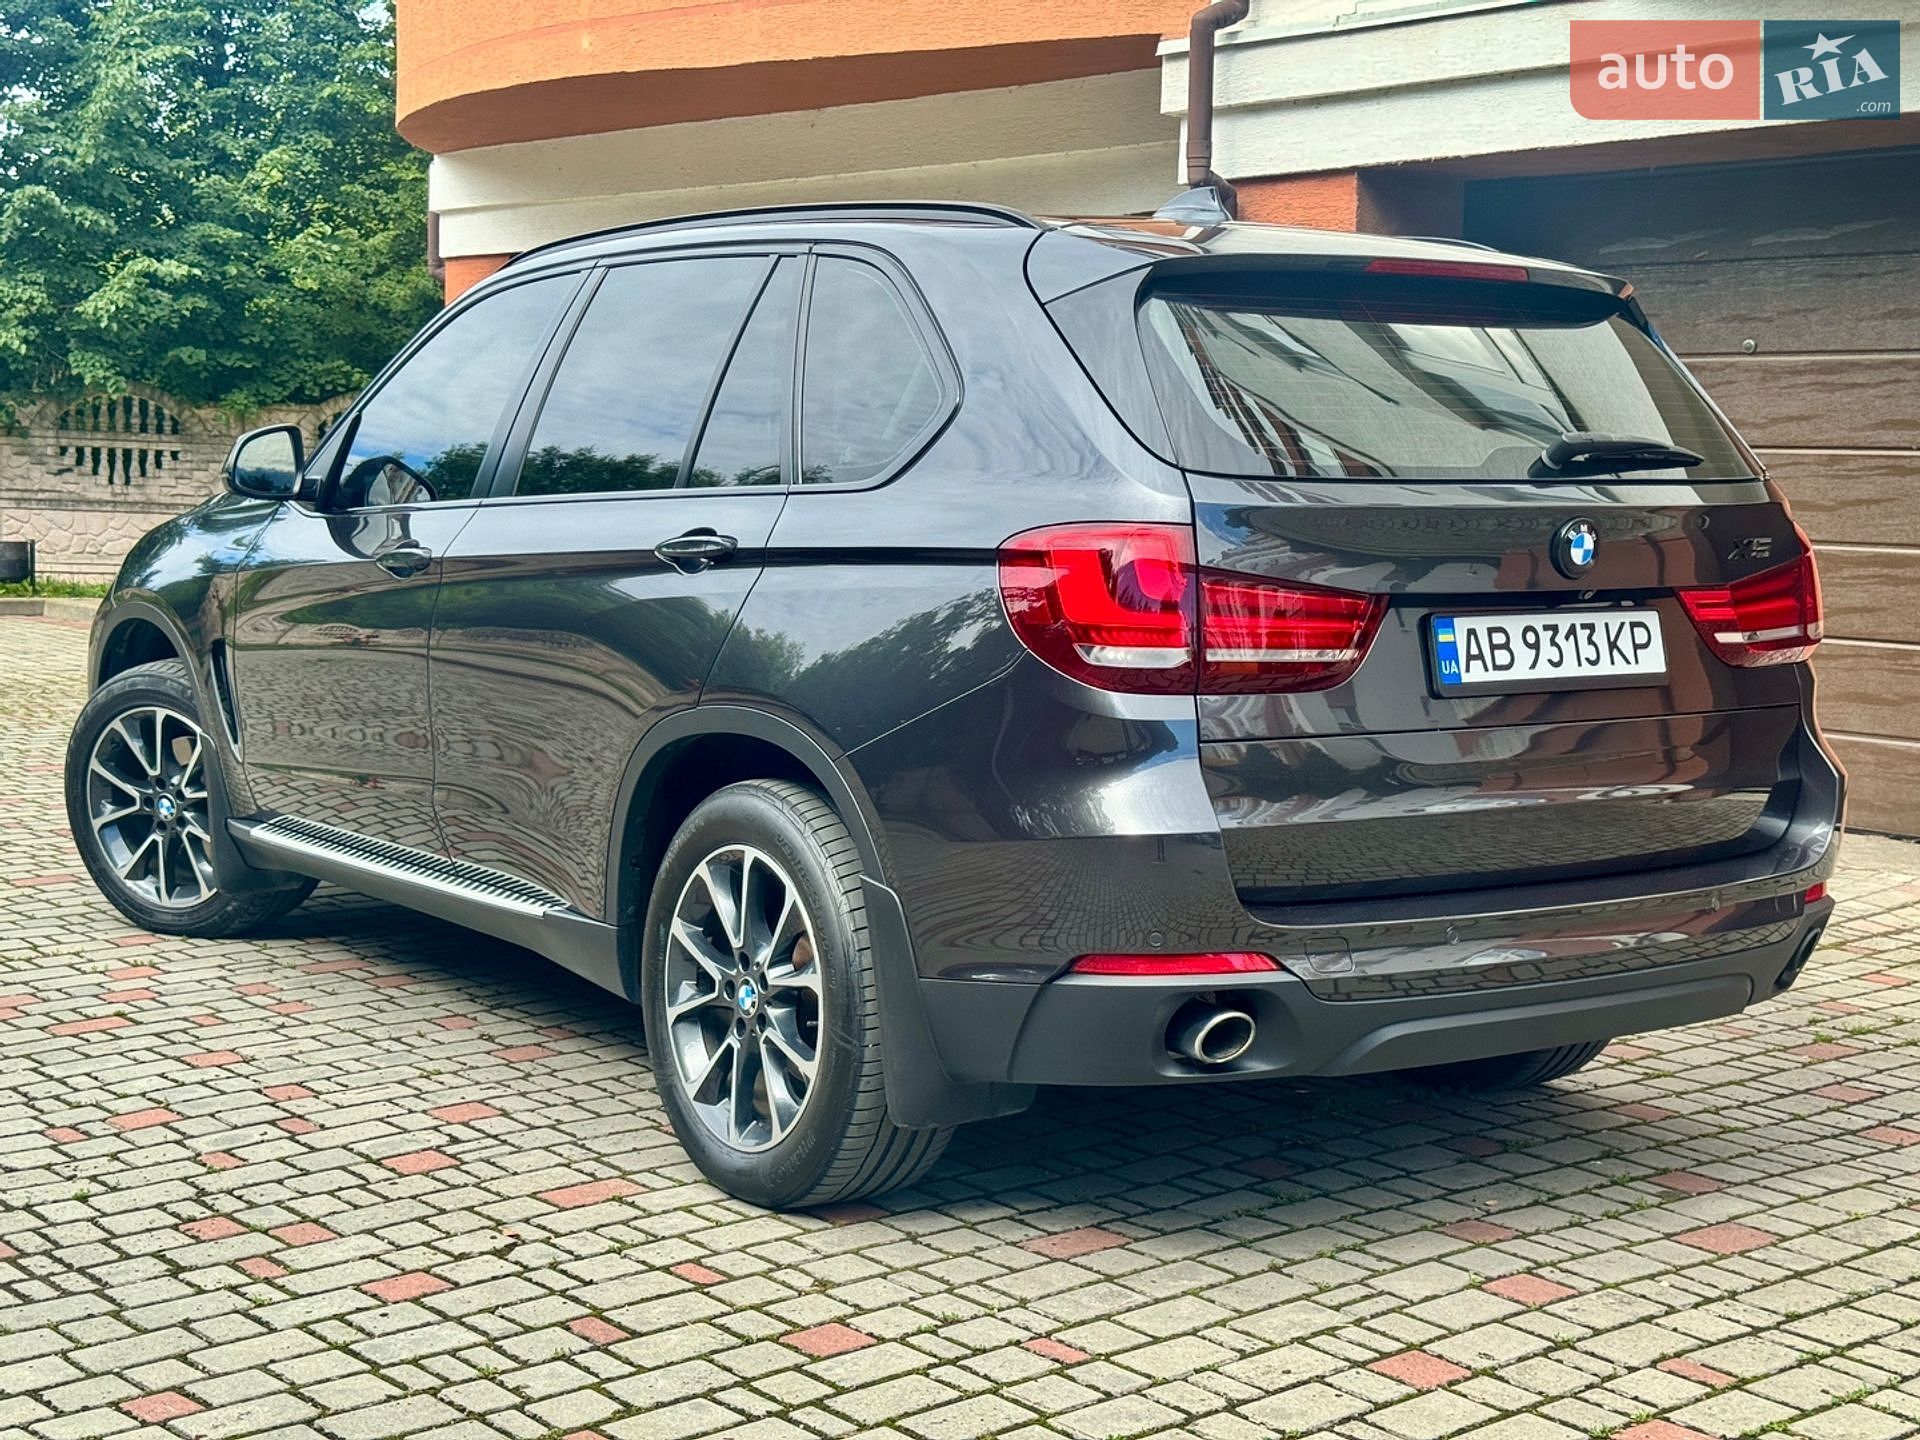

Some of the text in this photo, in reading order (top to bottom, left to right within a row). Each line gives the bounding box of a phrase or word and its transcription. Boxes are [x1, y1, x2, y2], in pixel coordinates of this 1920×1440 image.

[1465, 621, 1652, 673] AB 9313 KP
[1441, 660, 1459, 675] UA
